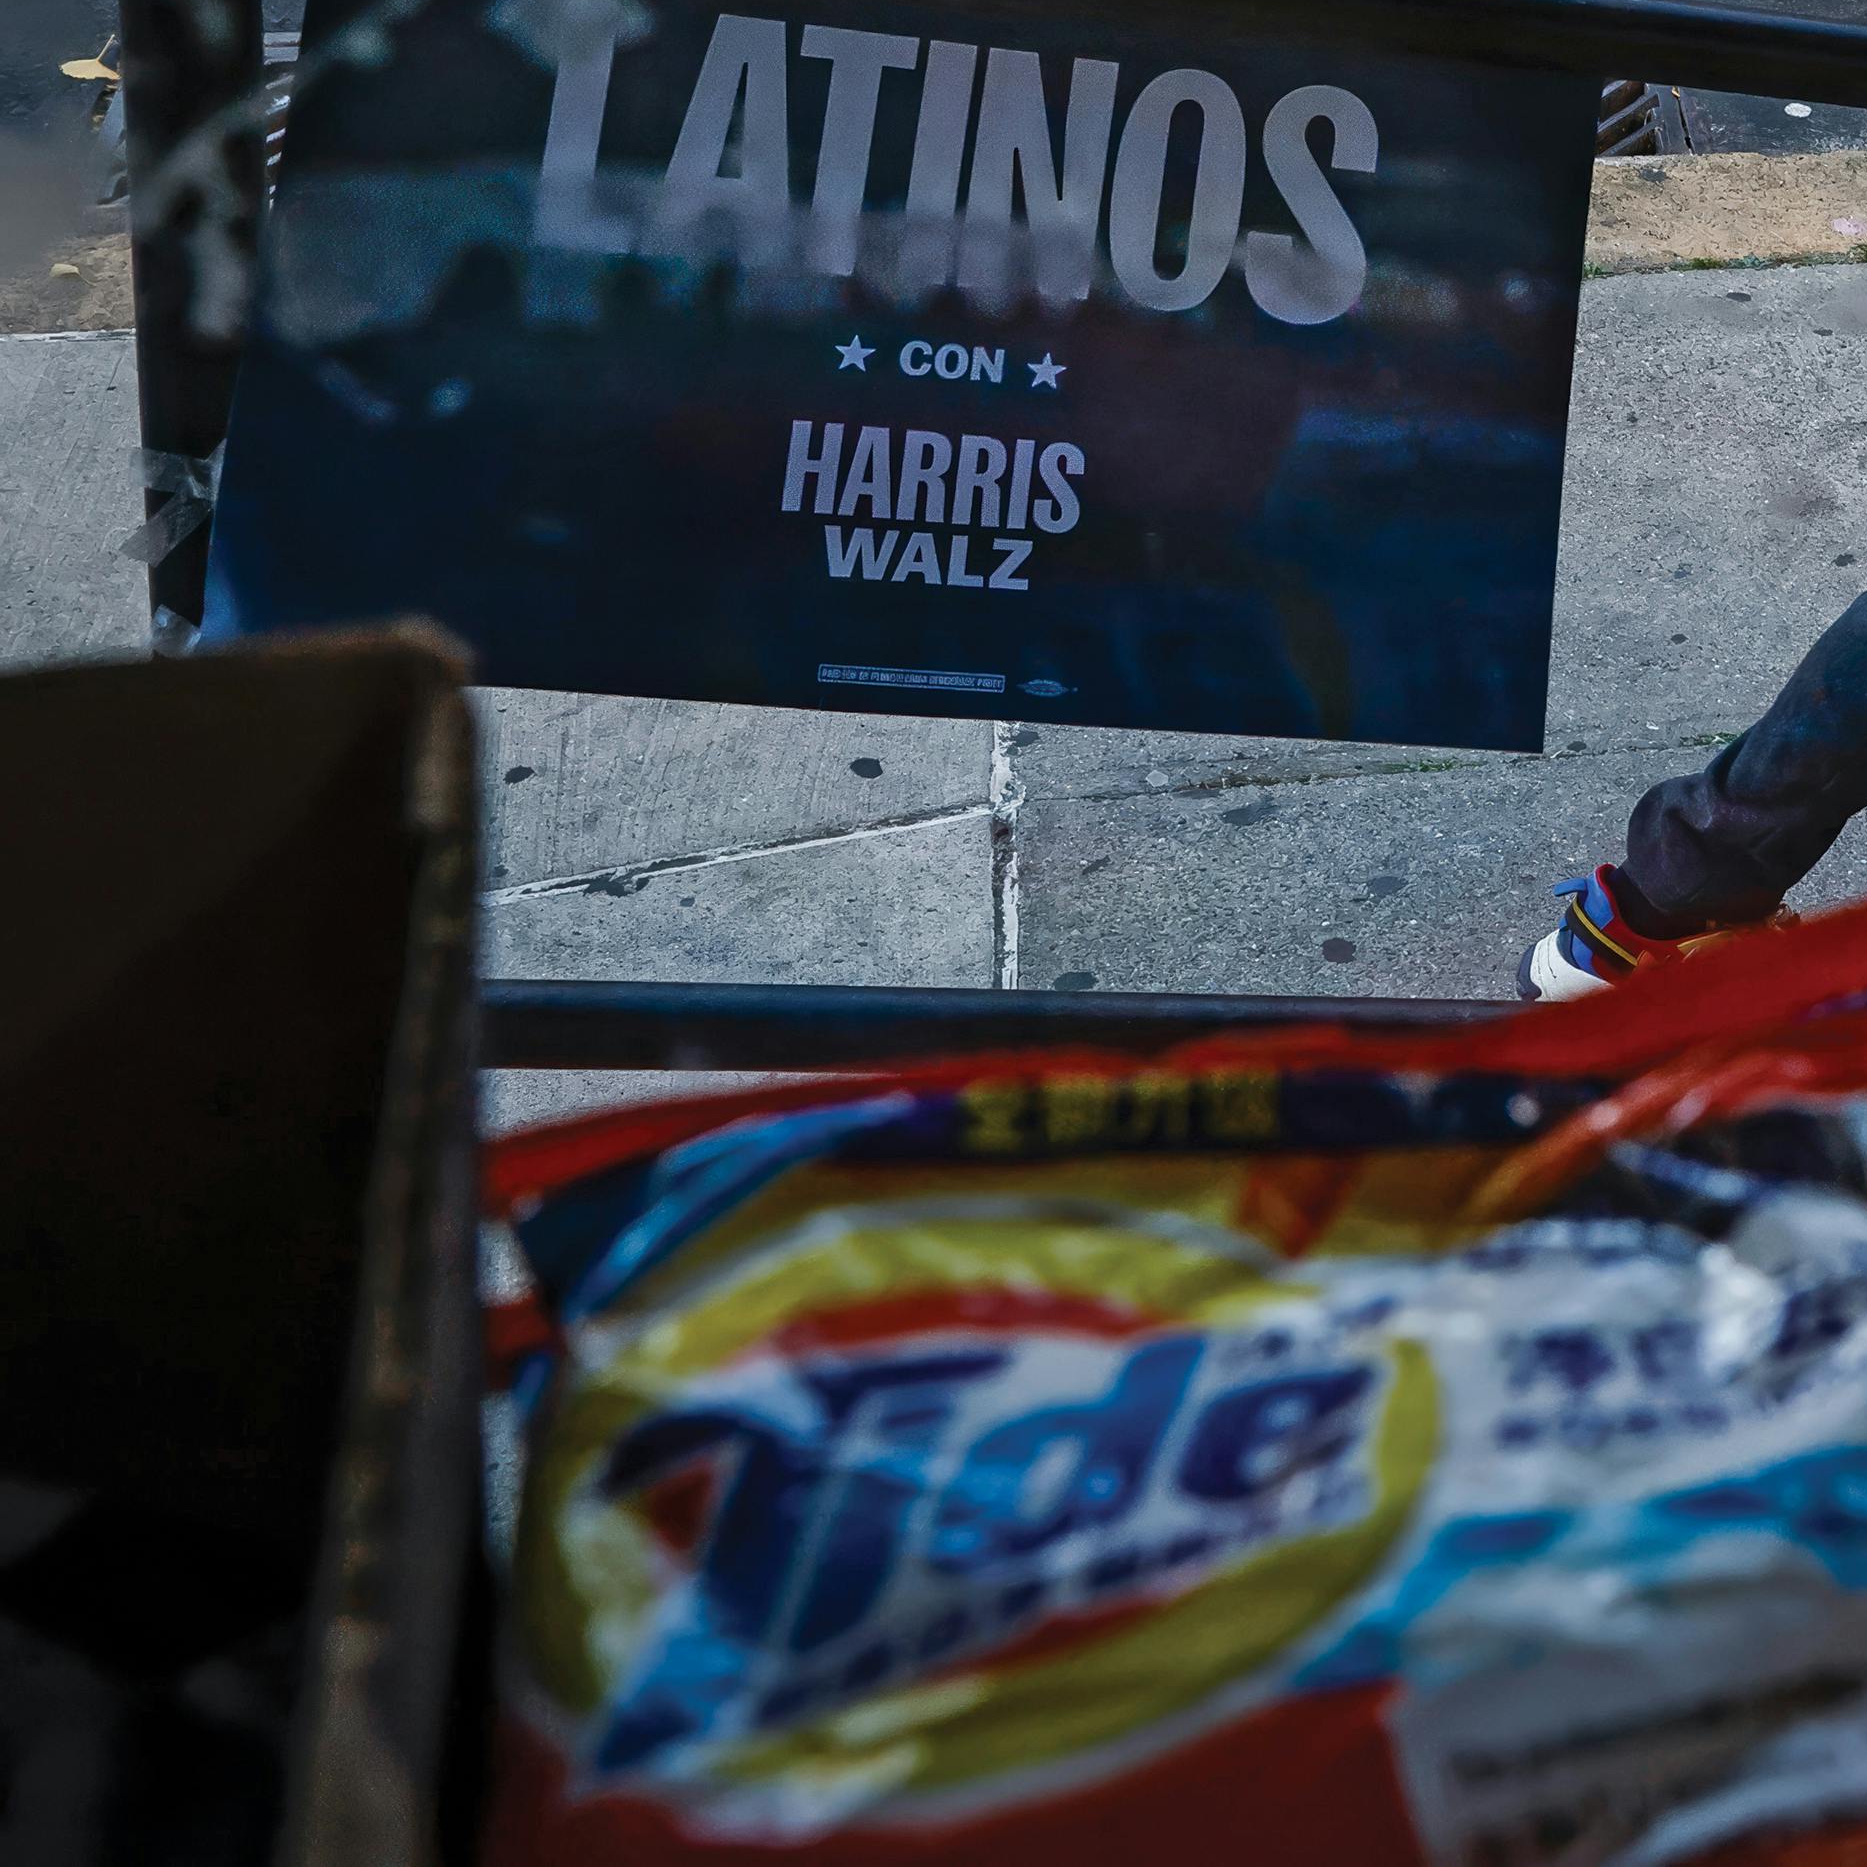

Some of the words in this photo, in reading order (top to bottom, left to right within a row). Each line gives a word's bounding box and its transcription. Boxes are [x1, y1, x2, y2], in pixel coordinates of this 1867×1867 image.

[900, 339, 1005, 383] CON
[781, 419, 1086, 534] HARRIS
[824, 524, 1034, 591] WALZ
[598, 1333, 1378, 1739] Tide
